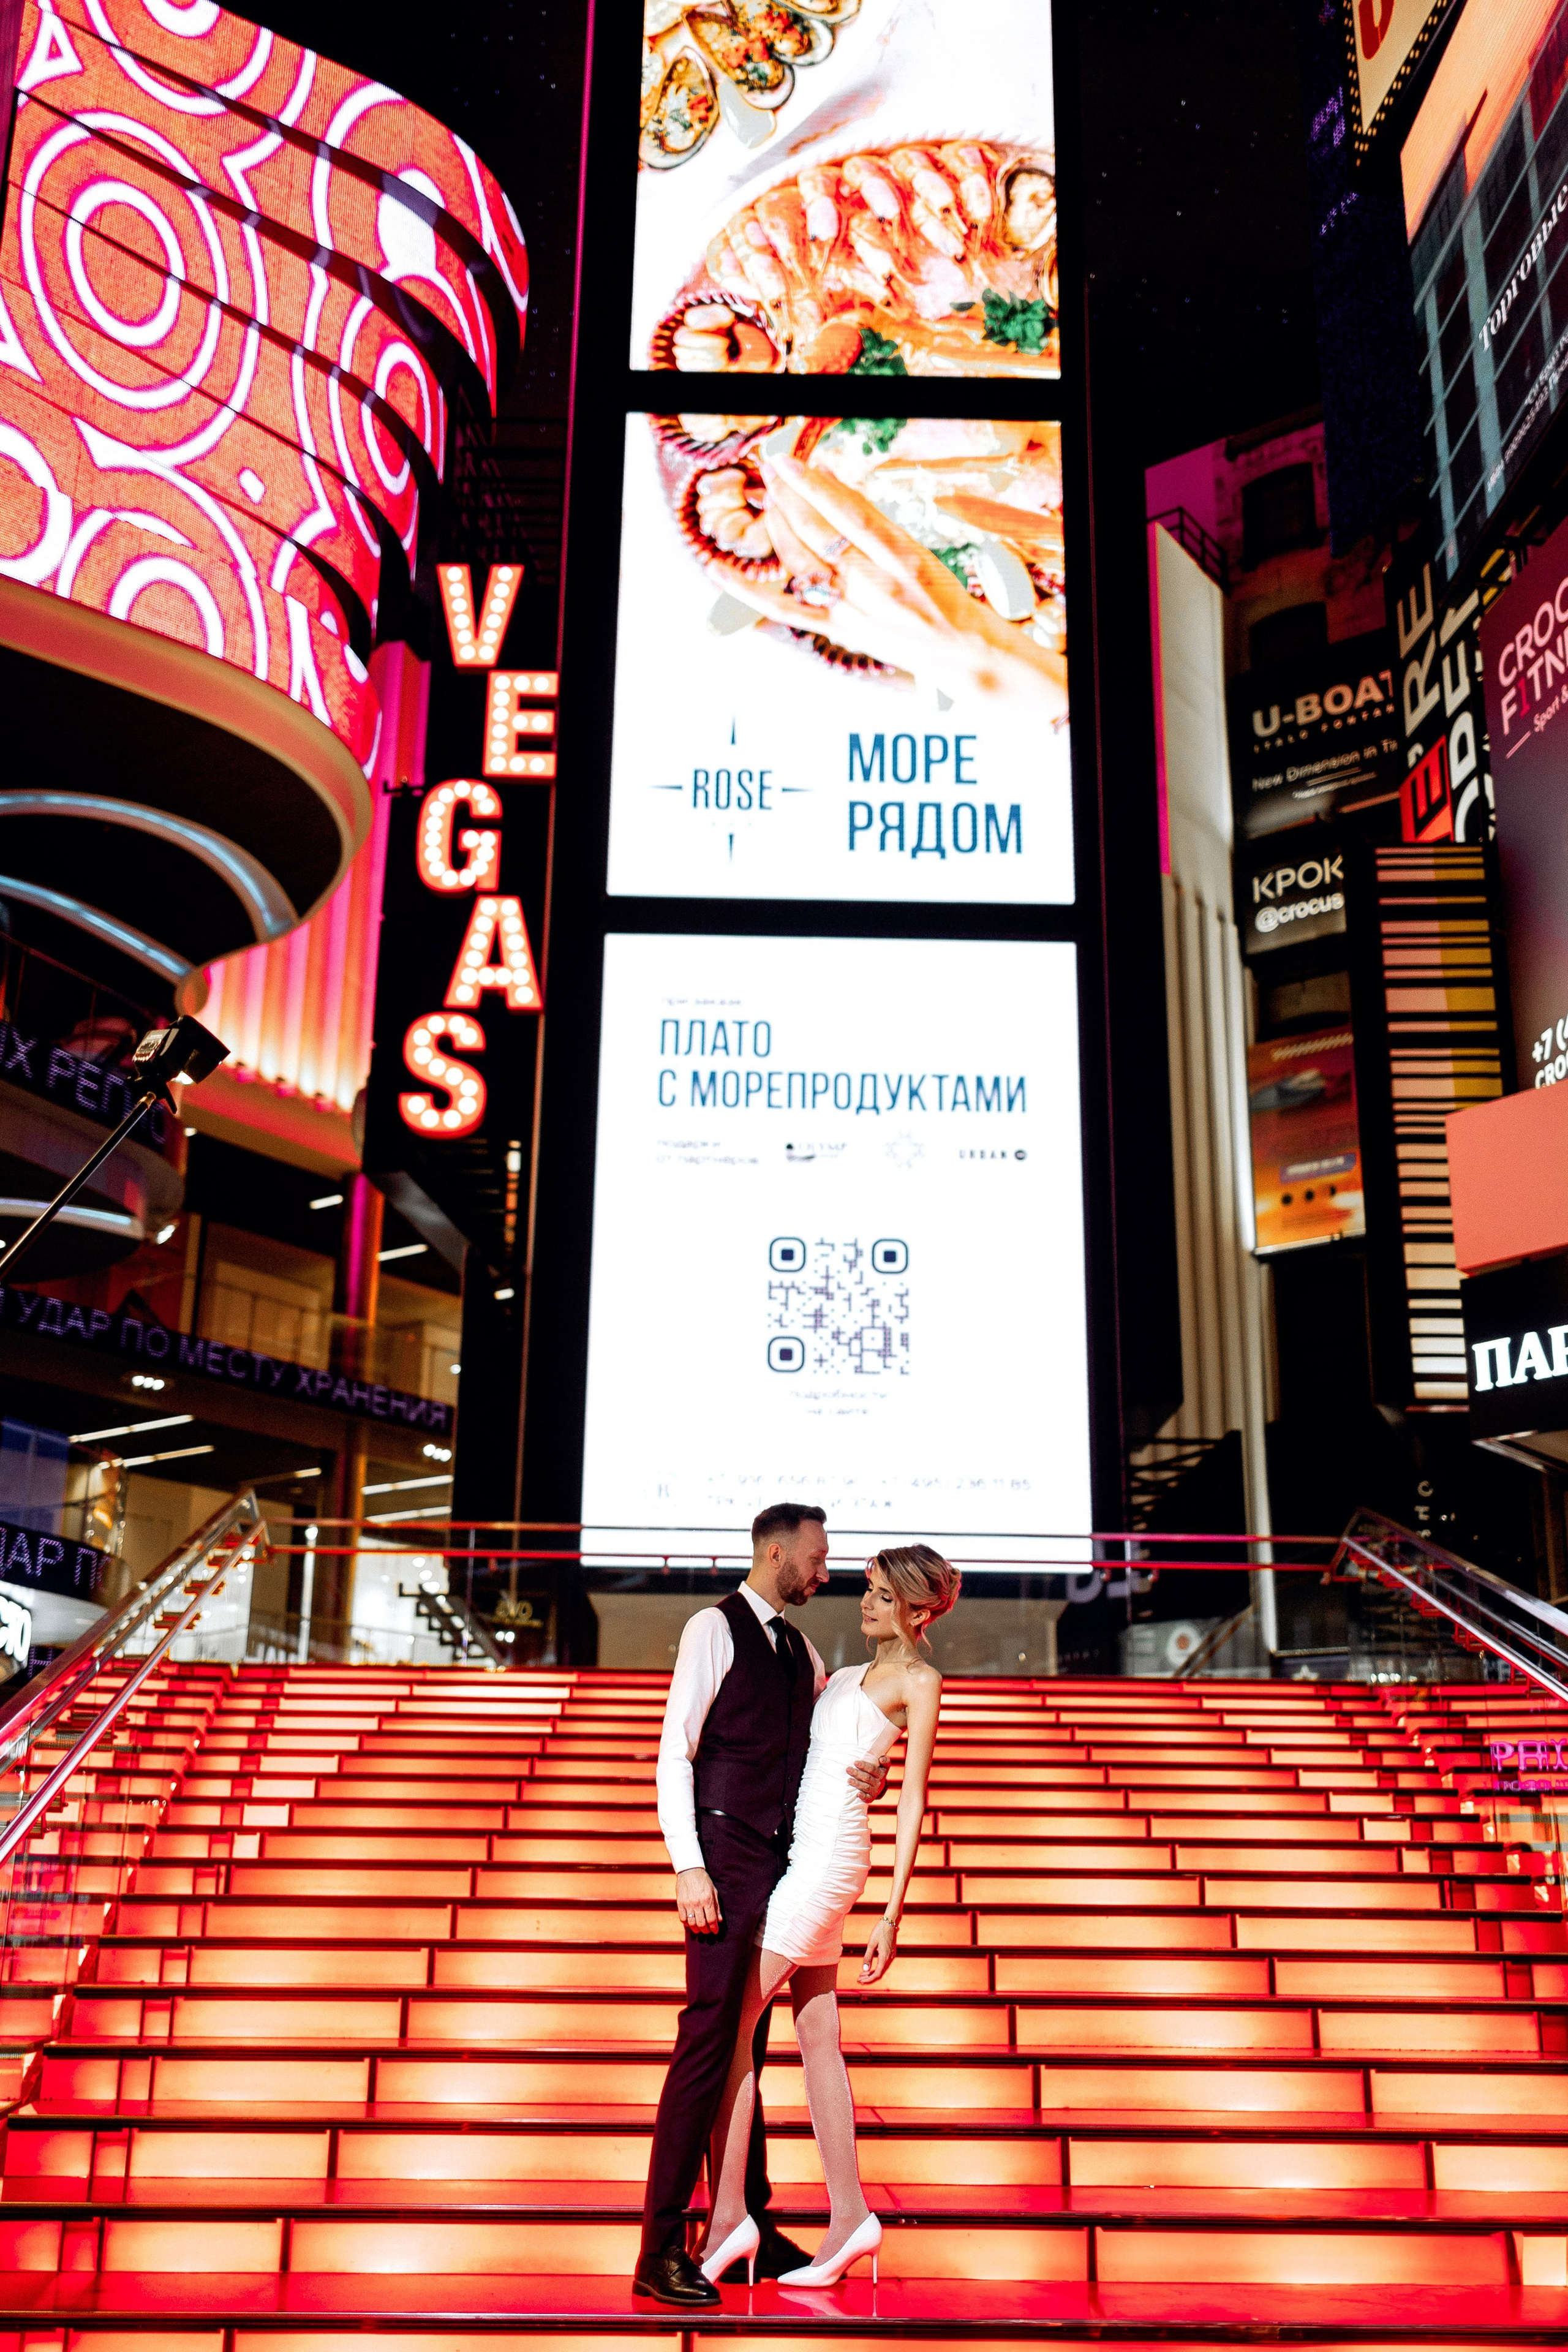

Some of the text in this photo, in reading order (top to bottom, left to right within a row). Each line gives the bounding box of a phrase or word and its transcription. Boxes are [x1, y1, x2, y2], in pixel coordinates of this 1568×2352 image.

[848, 733, 978, 785] МОРЕ
[692, 769, 774, 810] ROSE
[399, 564, 559, 1140] VEGAS
[848, 801, 1023, 859] РЯДОМ
[660, 1018, 772, 1059] ПЛАТО
[1532, 1027, 1553, 1063] +7
[657, 1068, 1027, 1117] С МОРЕПРОДУКТАМИ
[1535, 1049, 1568, 1089] CRO
[18, 1291, 111, 1340] УДАР
[119, 1317, 172, 1360] ПО
[178, 1334, 288, 1387] МЕСТУ
[294, 1366, 448, 1430] ХРАНЕНИЯ
